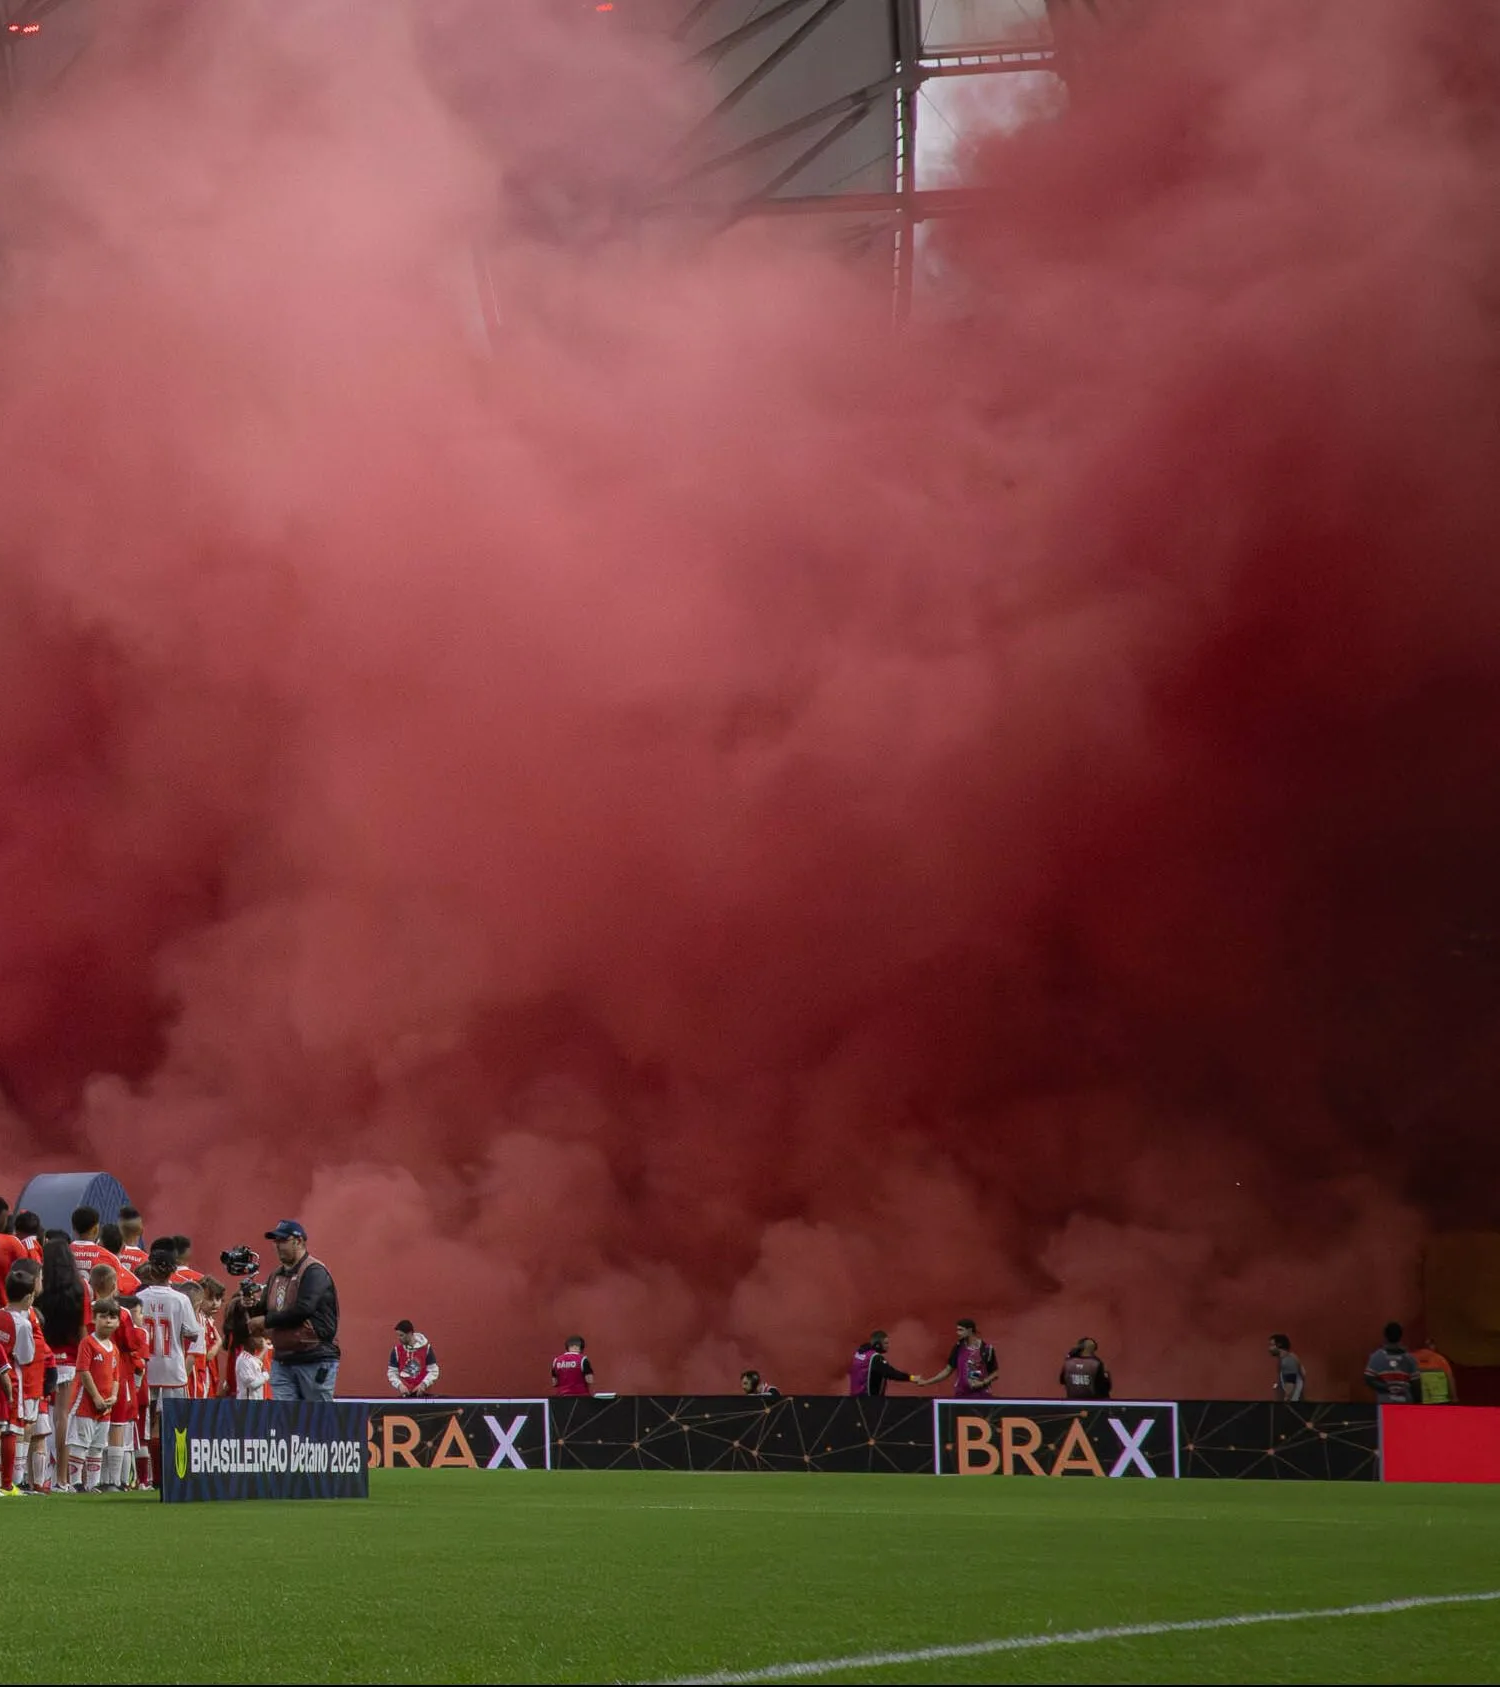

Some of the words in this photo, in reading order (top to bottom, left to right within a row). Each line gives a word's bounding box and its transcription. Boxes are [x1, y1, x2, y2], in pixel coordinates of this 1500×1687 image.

[191, 1429, 288, 1473] BRASILEIRÃO
[290, 1435, 328, 1473] Betano
[331, 1440, 361, 1473] 2025
[957, 1416, 1156, 1478] BRAX
